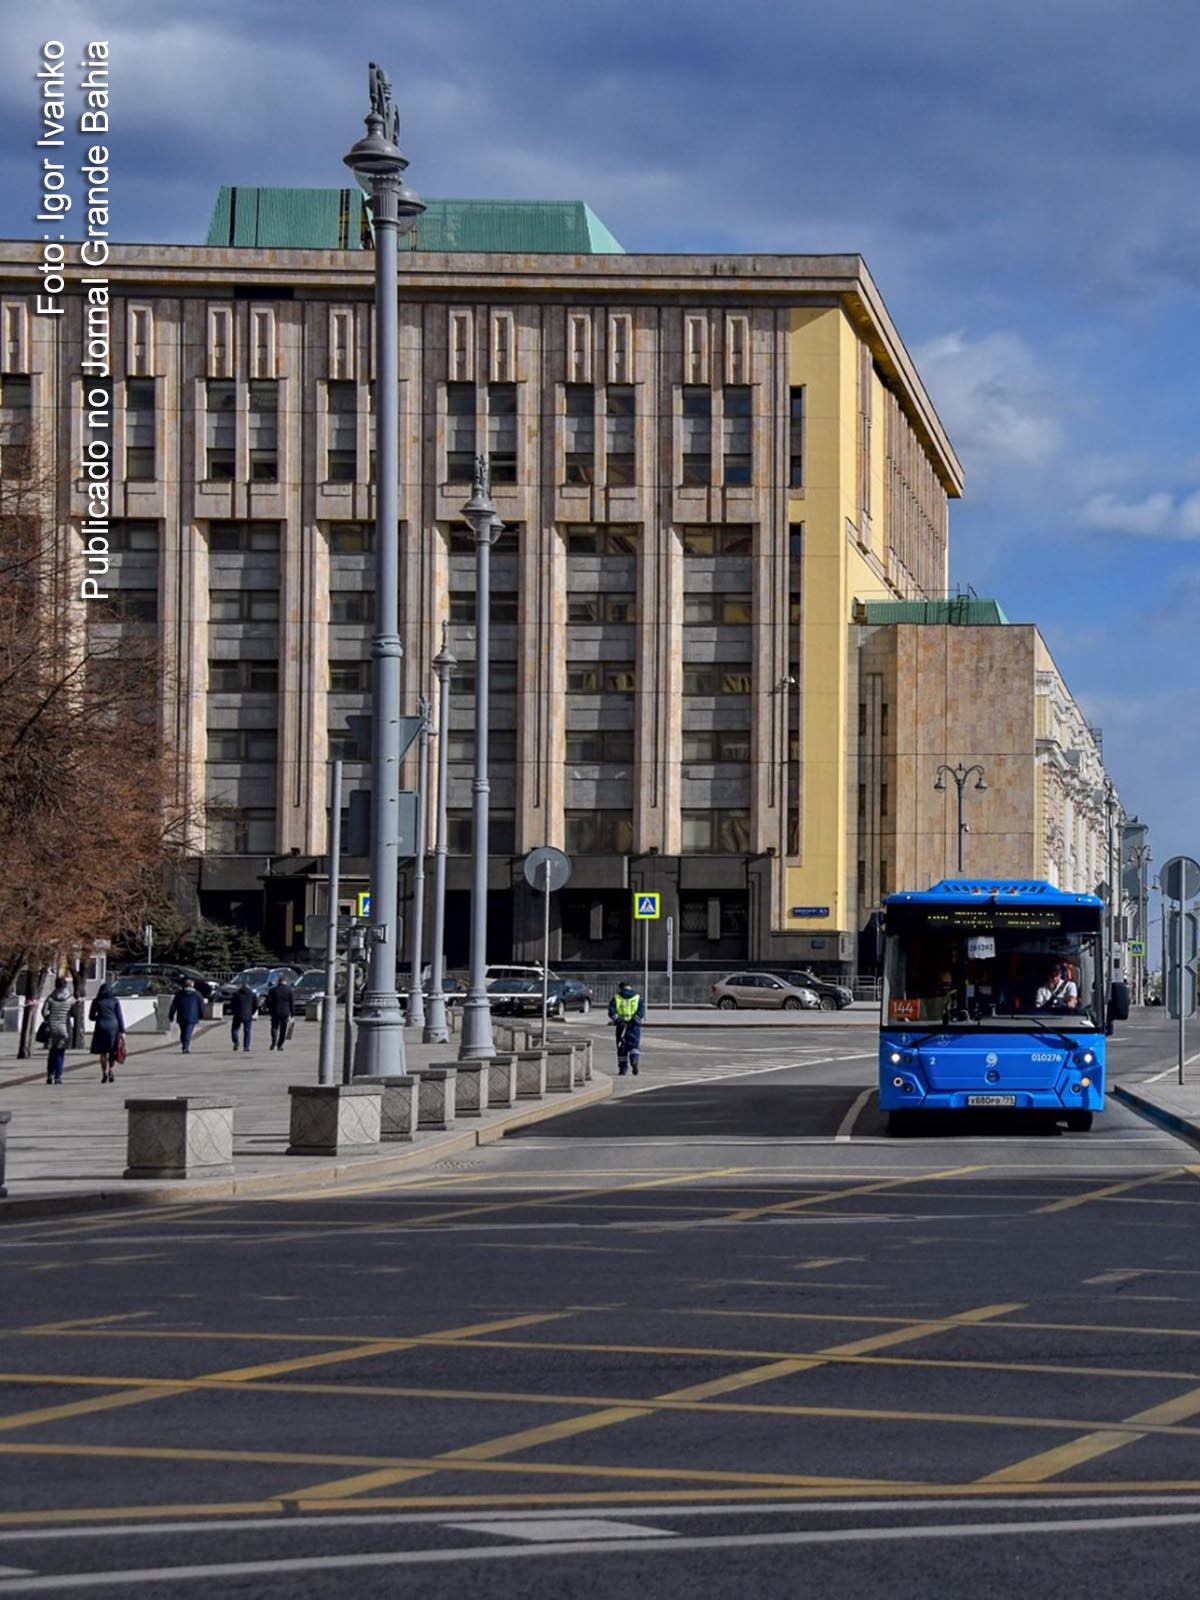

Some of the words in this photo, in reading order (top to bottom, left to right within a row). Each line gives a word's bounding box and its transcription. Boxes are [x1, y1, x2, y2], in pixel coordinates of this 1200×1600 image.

[893, 1001, 913, 1014] 144
[930, 1056, 936, 1065] 2
[1031, 1053, 1062, 1062] 010276
